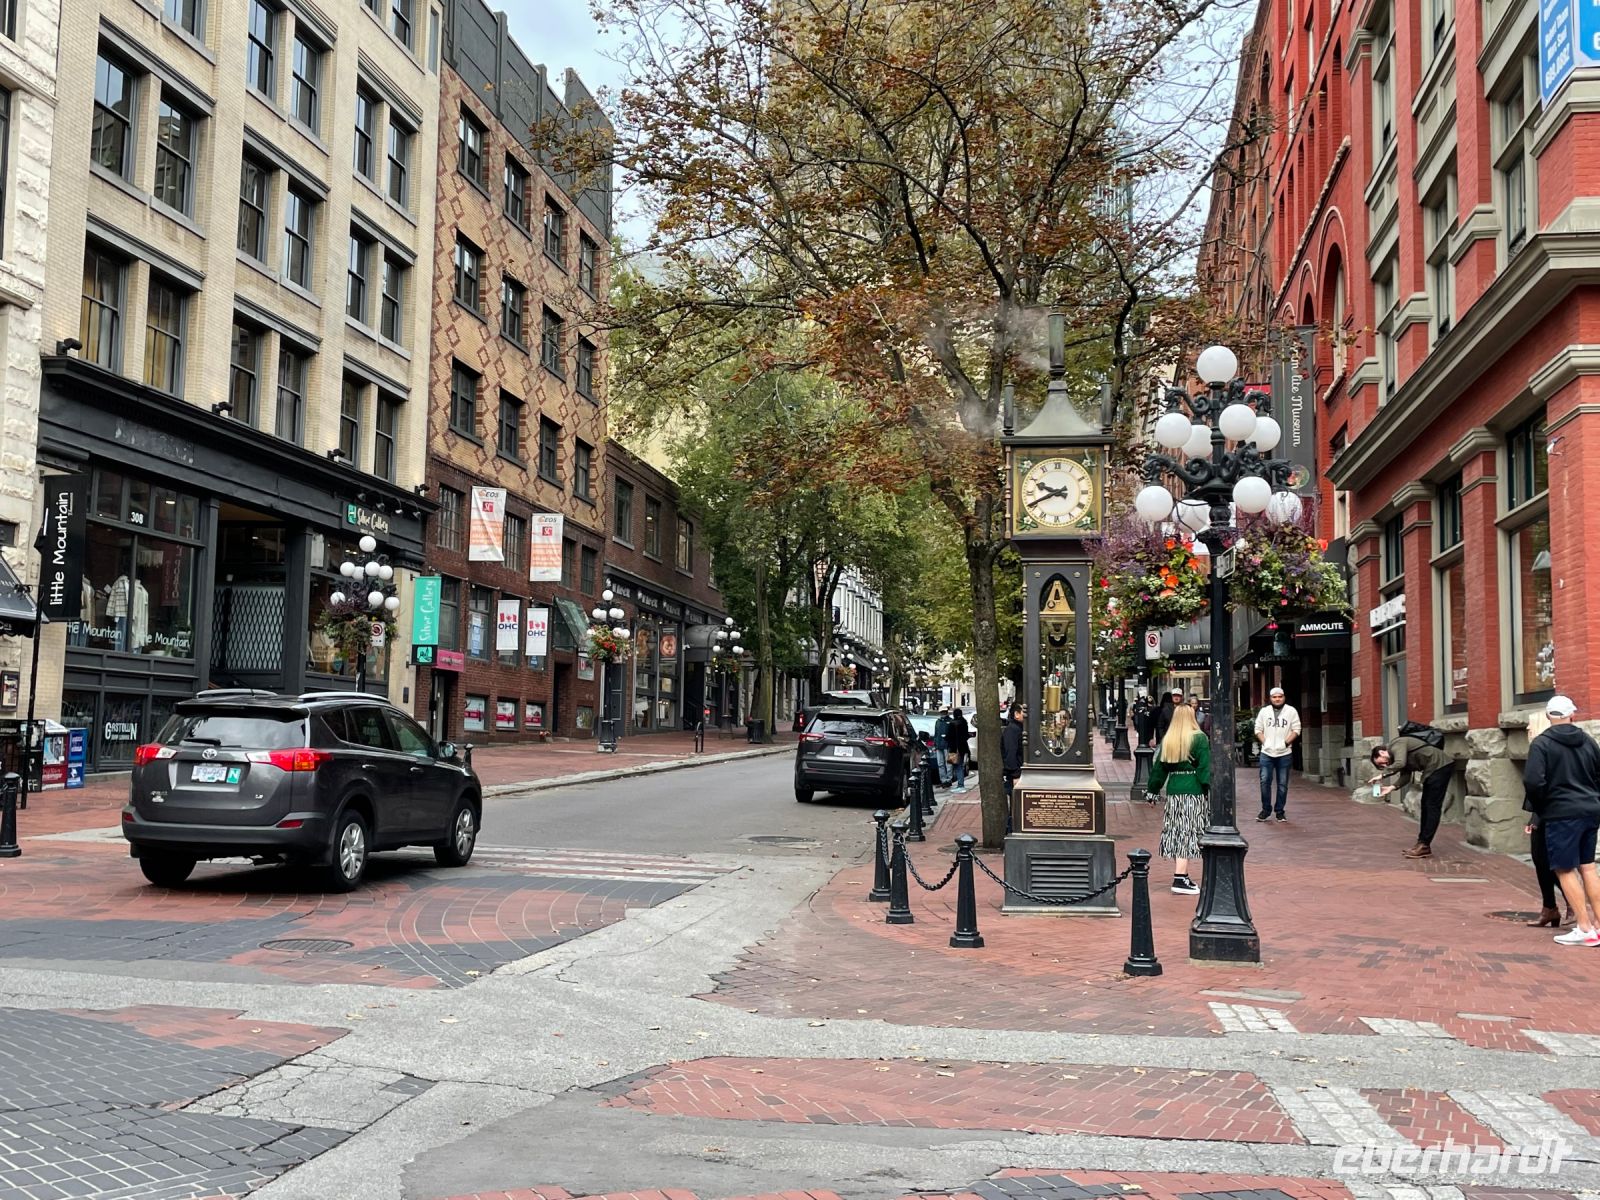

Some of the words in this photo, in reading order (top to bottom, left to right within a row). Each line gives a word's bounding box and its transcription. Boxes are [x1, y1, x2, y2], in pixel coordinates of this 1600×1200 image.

[1291, 395, 1303, 448] Museum
[52, 492, 68, 565] Mountain
[49, 571, 64, 606] little
[419, 615, 432, 641] Silver
[1299, 622, 1344, 632] AMMOLITE
[1178, 644, 1191, 652] 321
[105, 721, 138, 740] GASTOWN
[1266, 717, 1288, 728] GAP
[228, 768, 240, 779] N
